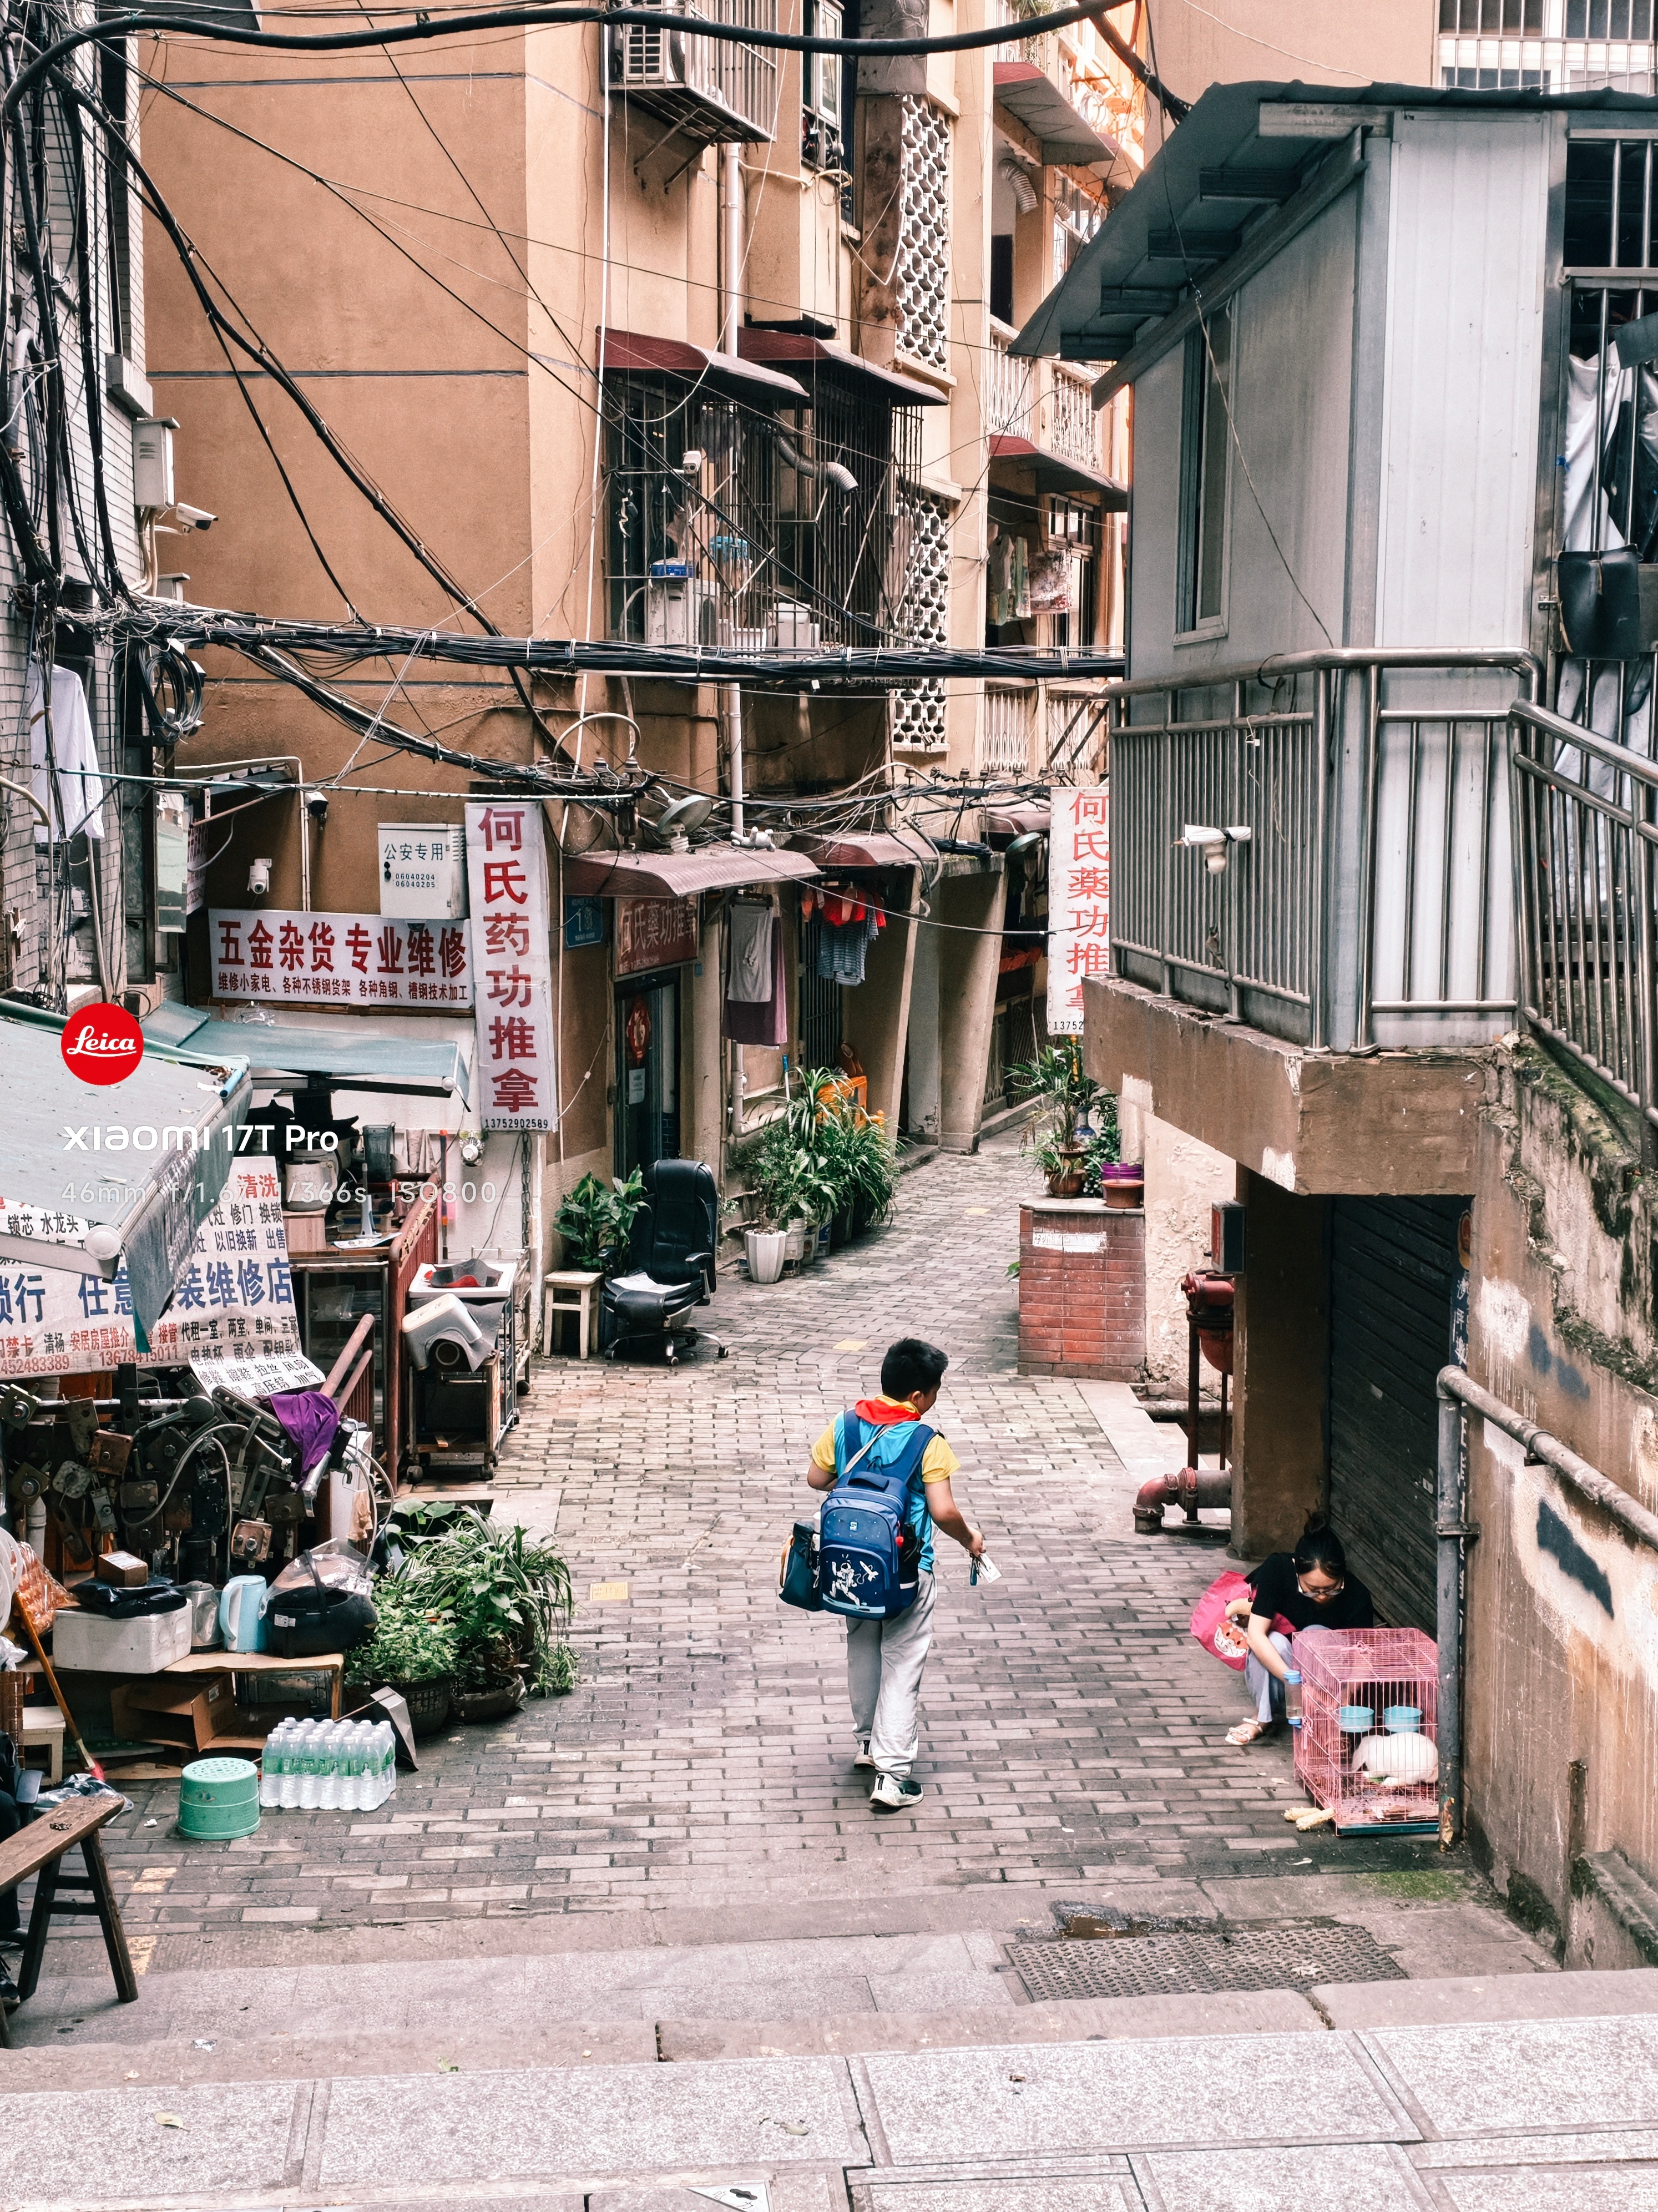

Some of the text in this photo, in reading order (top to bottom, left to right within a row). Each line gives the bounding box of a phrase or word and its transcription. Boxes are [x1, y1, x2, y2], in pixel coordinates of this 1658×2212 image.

[384, 842, 443, 861] 公安专用
[218, 918, 467, 977] 五金杂货 专业维修
[477, 807, 539, 1113] 何氏药功推拿
[1053, 1020, 1084, 1031] 13752
[484, 1118, 549, 1129] 13752902589
[236, 1173, 279, 1199] 清洗
[8, 1213, 34, 1236] 锁芯
[40, 1212, 79, 1234] 水龙头
[230, 1203, 254, 1225] 修门
[259, 1201, 282, 1224] 换锁
[214, 1229, 257, 1252] 以旧换新
[266, 1227, 286, 1249] 出售
[78, 1256, 292, 1319] 任意装维修店
[69, 1326, 129, 1351] 安居房屋推介
[232, 1341, 256, 1363] 雨伞
